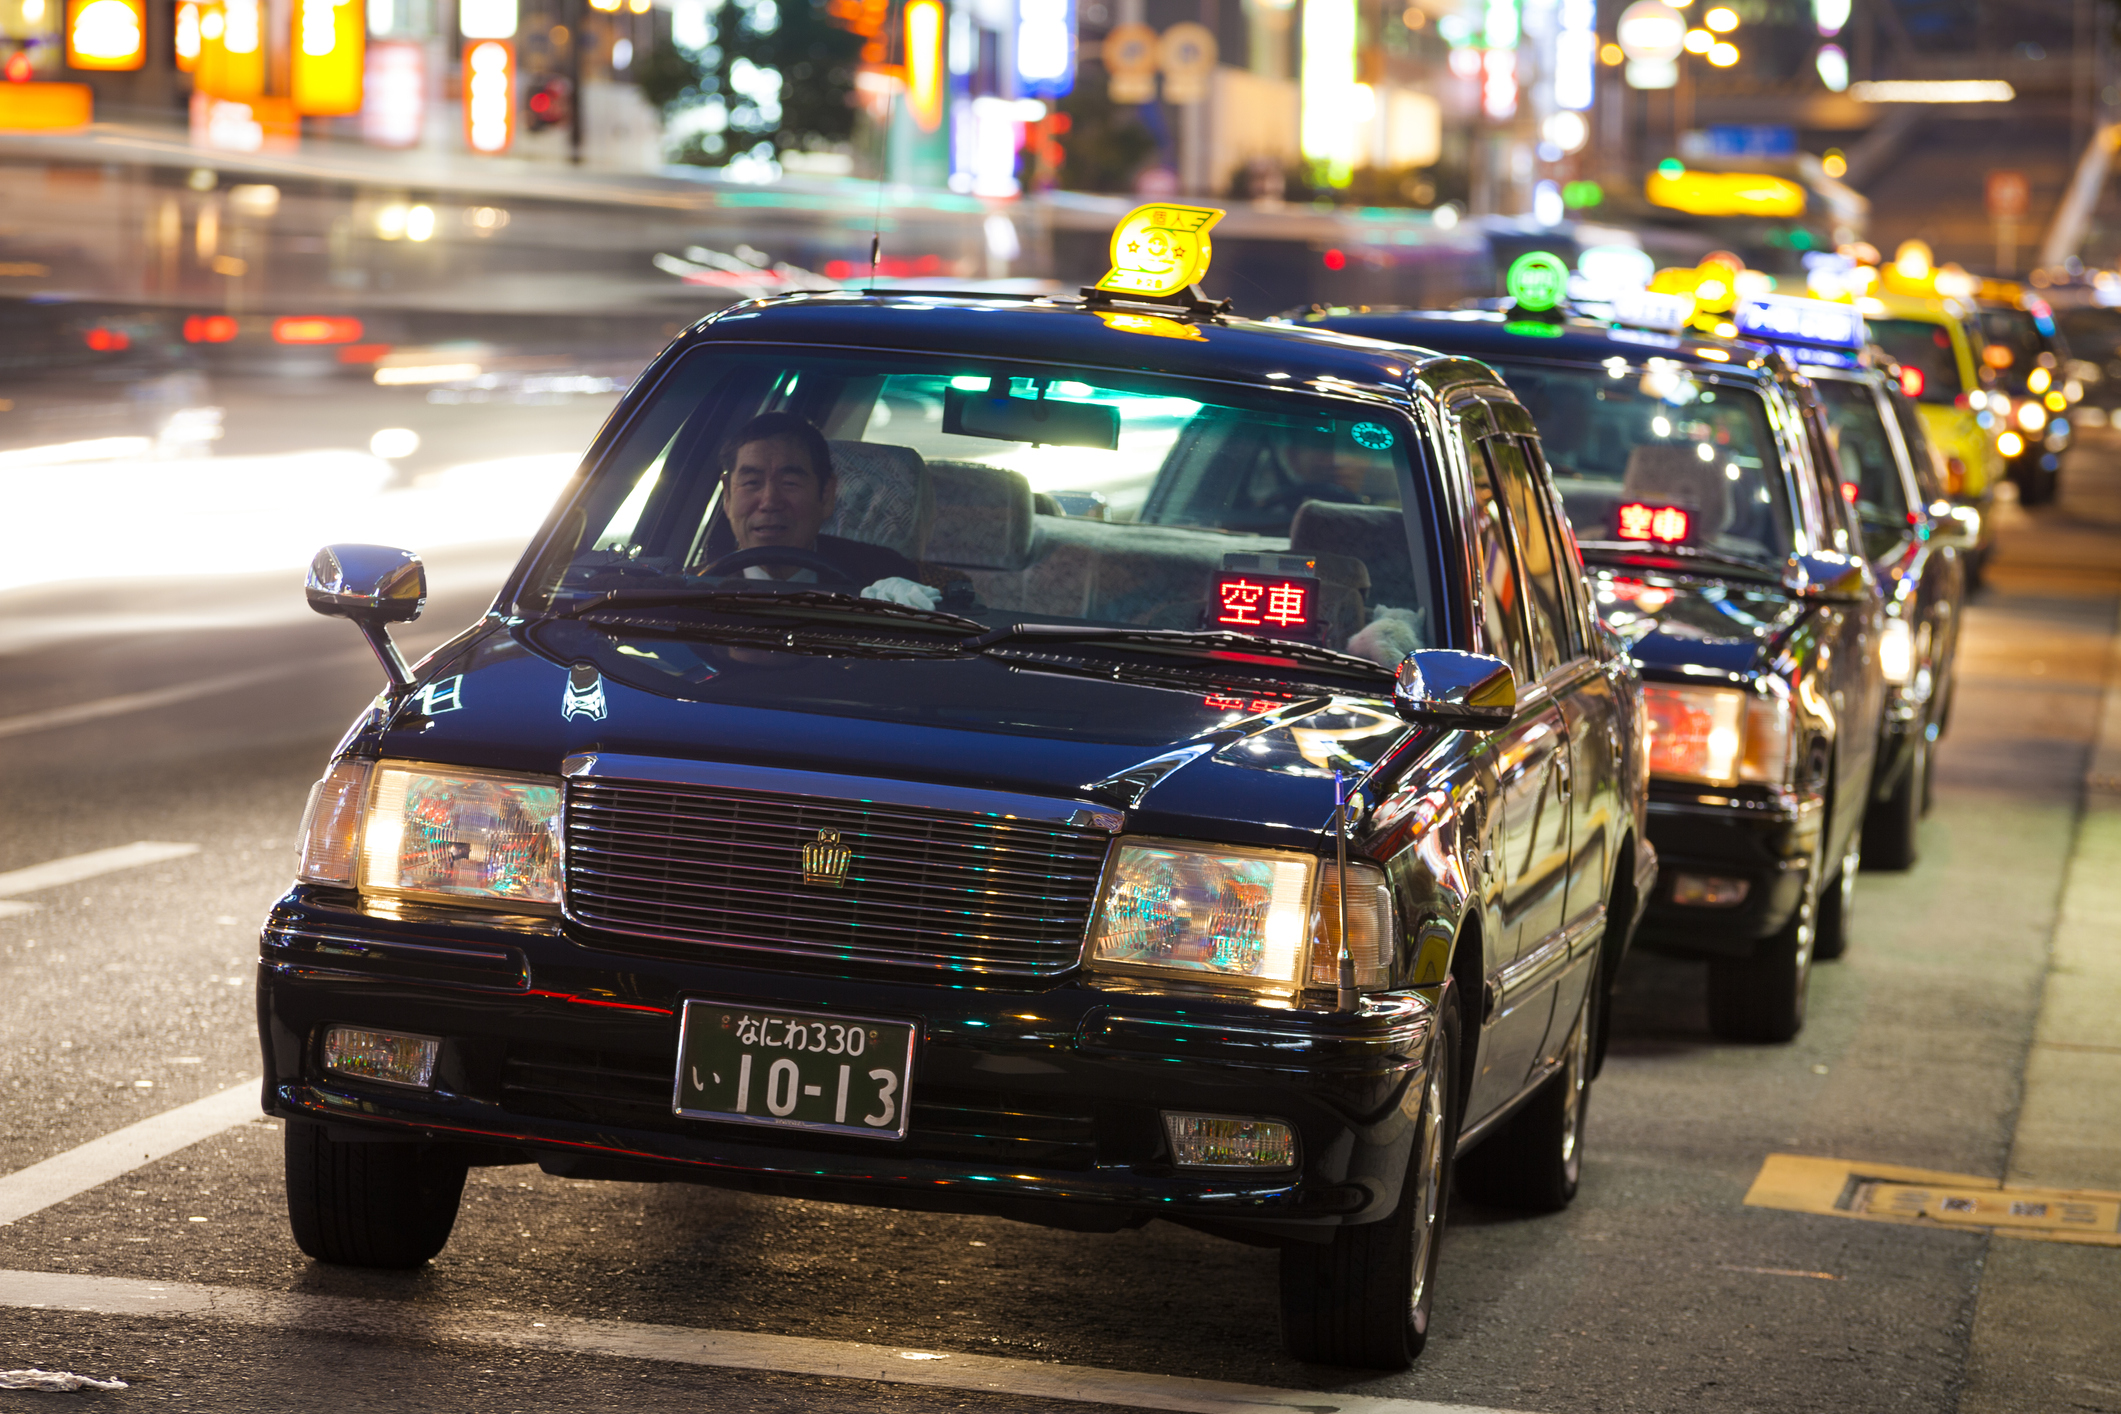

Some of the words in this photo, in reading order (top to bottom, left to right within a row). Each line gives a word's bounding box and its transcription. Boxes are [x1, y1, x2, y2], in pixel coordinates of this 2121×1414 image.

[1152, 210, 1185, 228] 個人
[1218, 579, 1306, 627] 空車
[692, 1066, 721, 1091] い
[736, 1054, 898, 1127] 10-13
